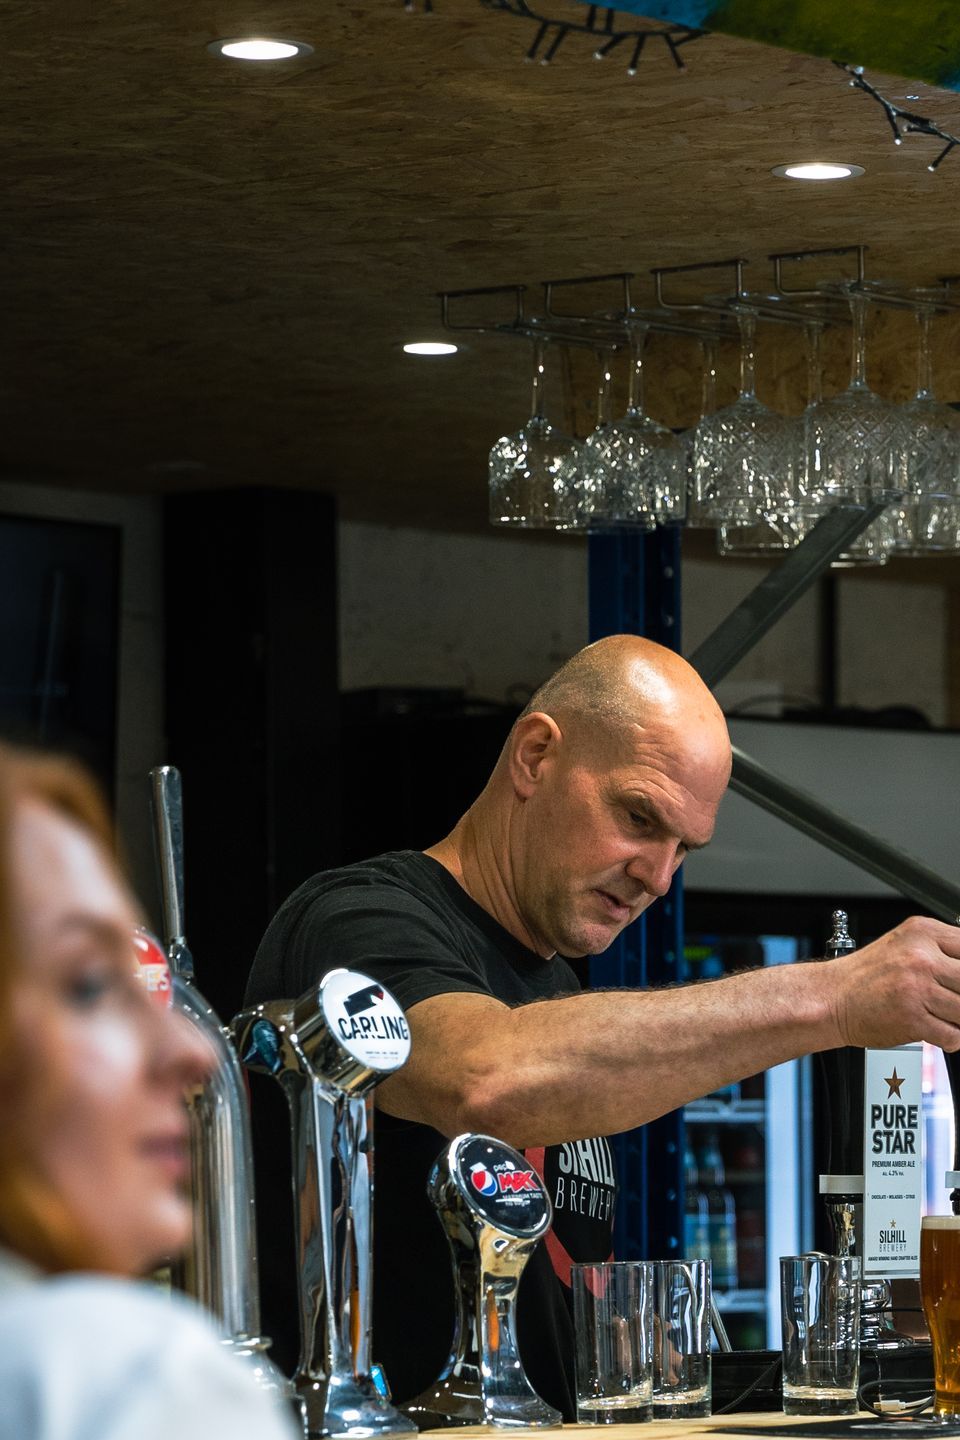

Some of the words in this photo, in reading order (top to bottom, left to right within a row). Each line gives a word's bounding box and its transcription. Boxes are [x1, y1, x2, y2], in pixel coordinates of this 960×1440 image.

[338, 1016, 409, 1041] CARLING
[871, 1104, 918, 1129] PURE
[872, 1130, 916, 1154] STAR
[871, 1160, 891, 1168] PREMIUM
[497, 1170, 542, 1194] MAX
[879, 1229, 907, 1244] SILHILL
[879, 1244, 907, 1253] BREWERY
